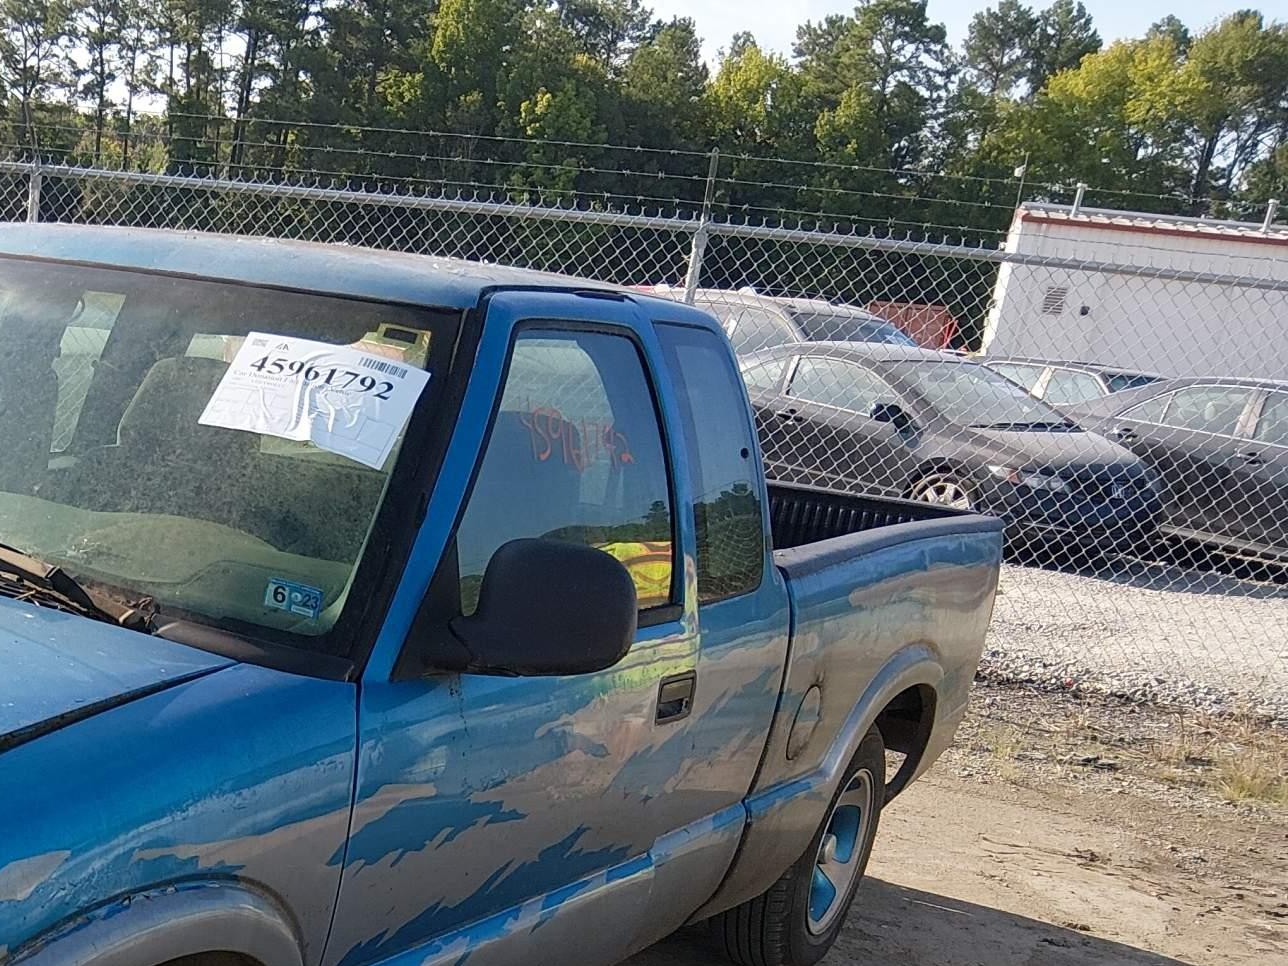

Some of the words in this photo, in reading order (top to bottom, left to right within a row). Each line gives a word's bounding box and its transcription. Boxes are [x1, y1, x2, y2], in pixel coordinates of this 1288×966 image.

[249, 355, 395, 401] 45961792
[272, 586, 286, 604] 6
[302, 593, 319, 609] 23
